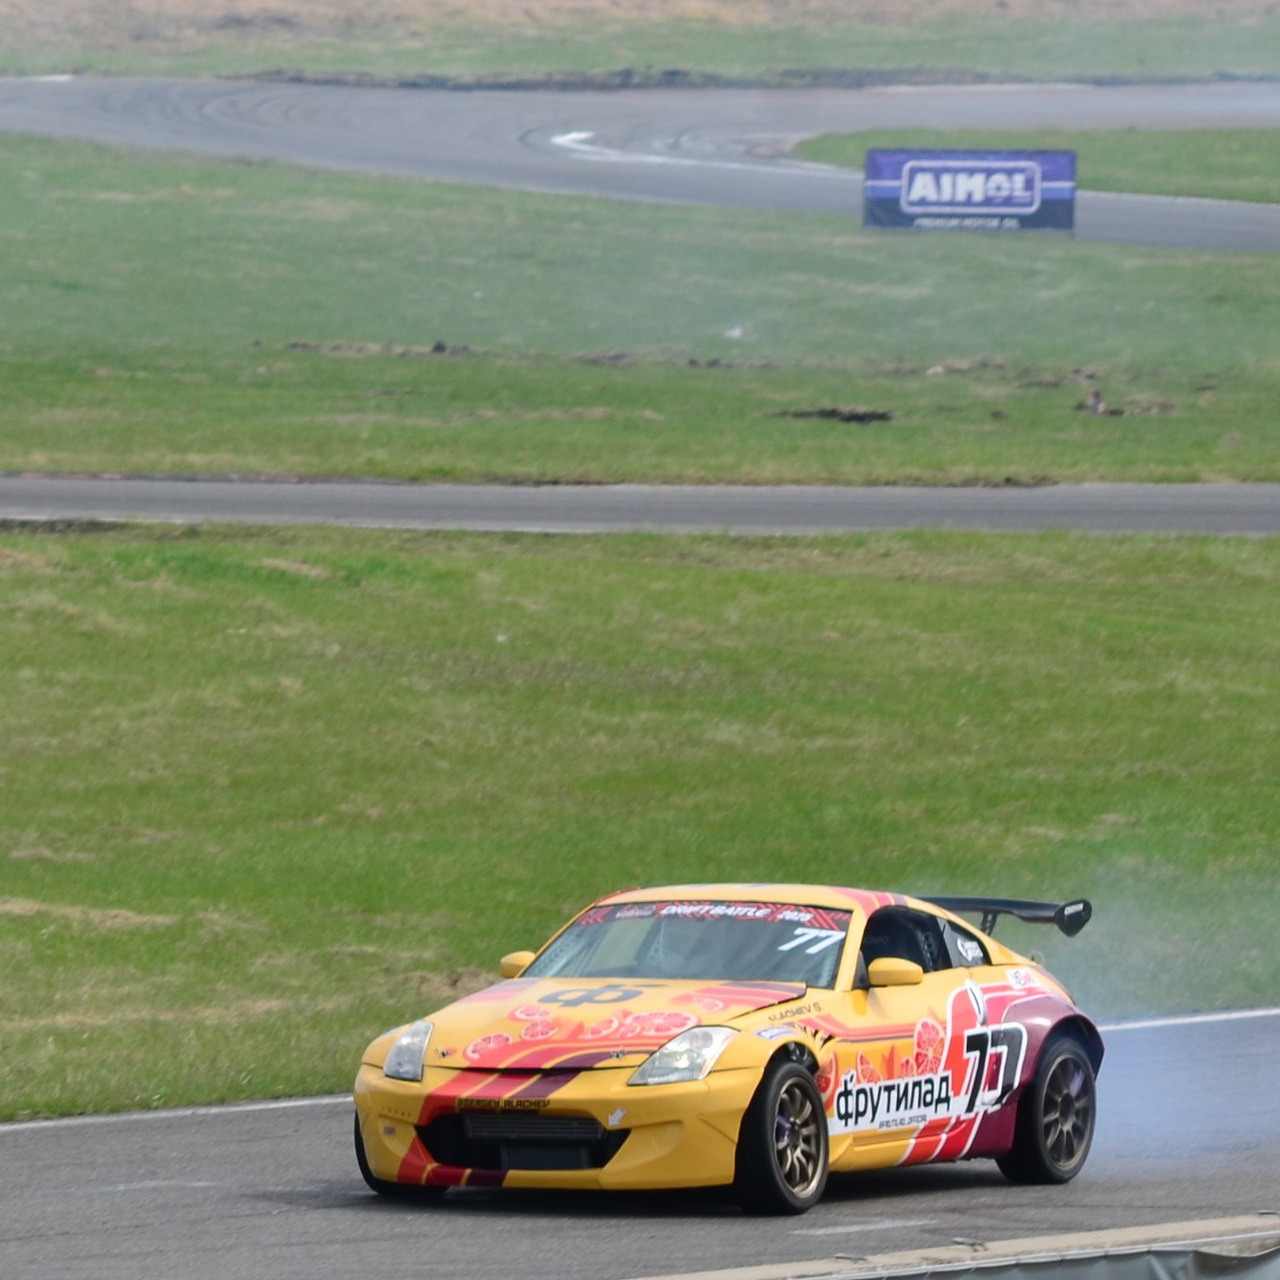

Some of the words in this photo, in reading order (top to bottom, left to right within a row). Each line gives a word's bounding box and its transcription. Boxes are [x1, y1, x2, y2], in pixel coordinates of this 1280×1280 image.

[909, 172, 1032, 203] AIMOL
[777, 927, 846, 954] 77
[965, 1026, 1024, 1114] 77
